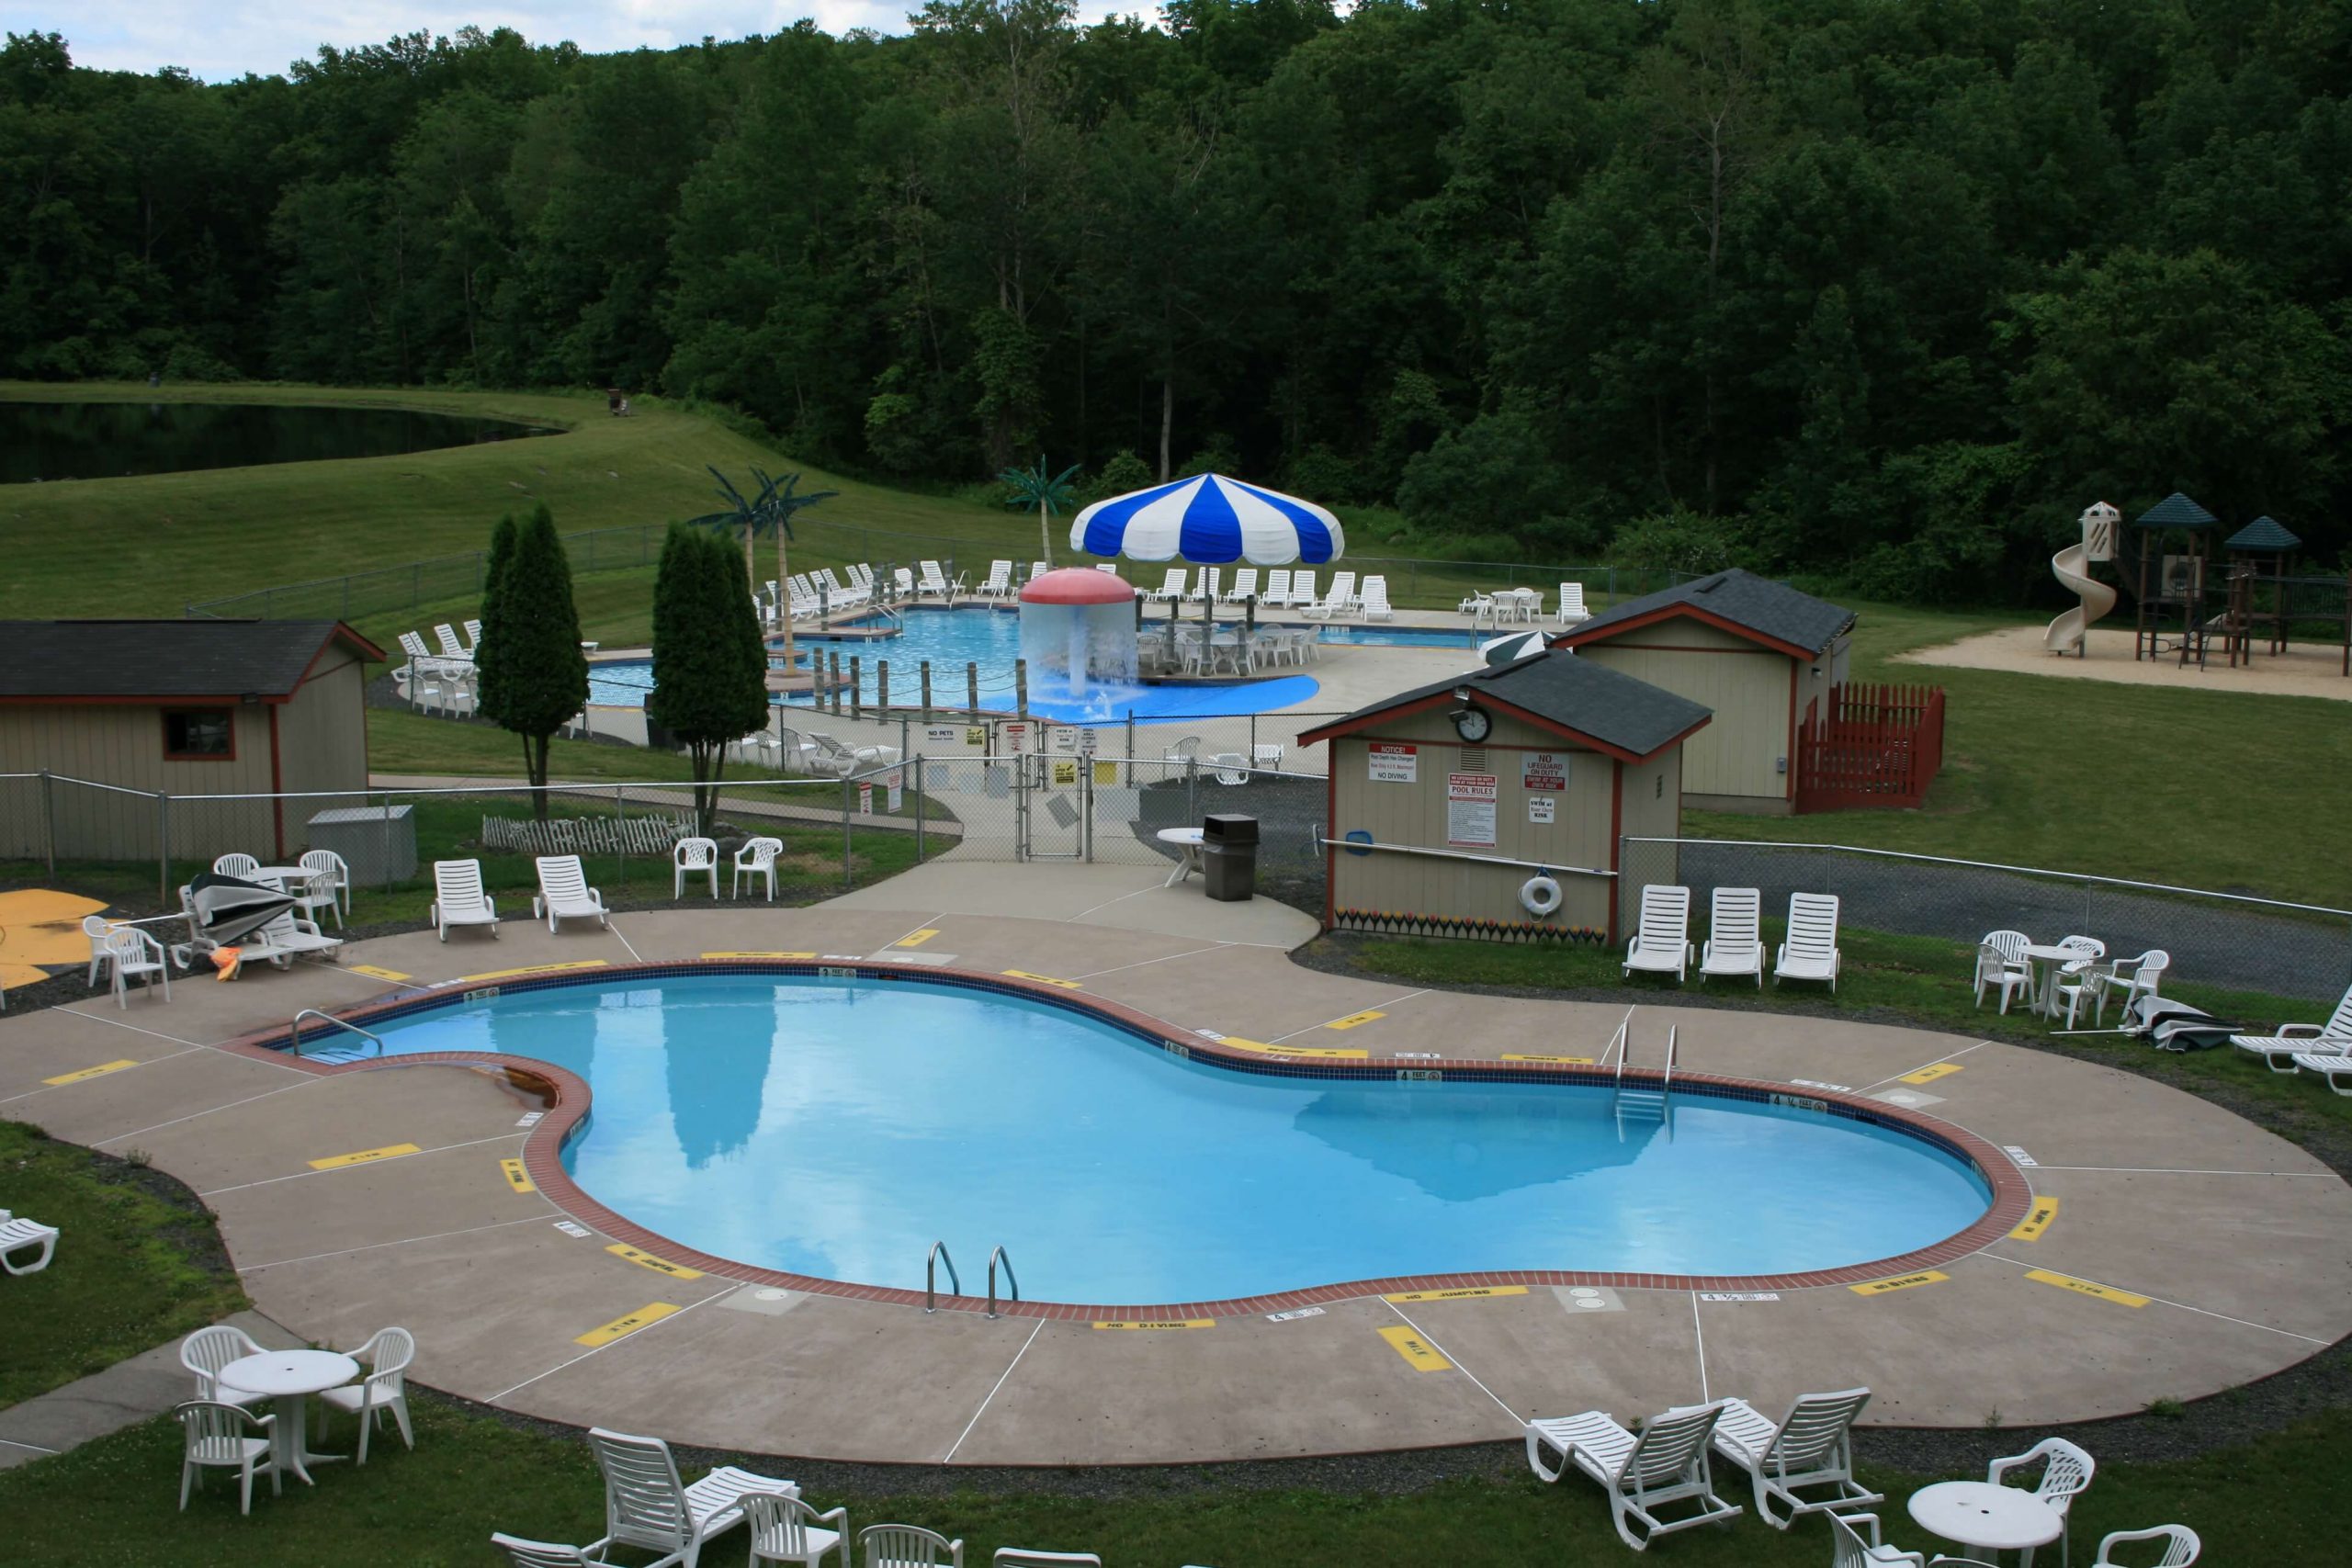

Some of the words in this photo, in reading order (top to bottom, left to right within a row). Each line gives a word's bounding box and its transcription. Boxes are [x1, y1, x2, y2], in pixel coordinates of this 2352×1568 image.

[1381, 746, 1406, 754] NOTICE!
[1539, 754, 1552, 762] NO
[1401, 1070, 1408, 1080] 4
[1773, 1094, 1780, 1105] 4
[1439, 1289, 1491, 1298] JUMPING
[609, 1318, 639, 1332] WALK
[1405, 1340, 1429, 1355] WALK
